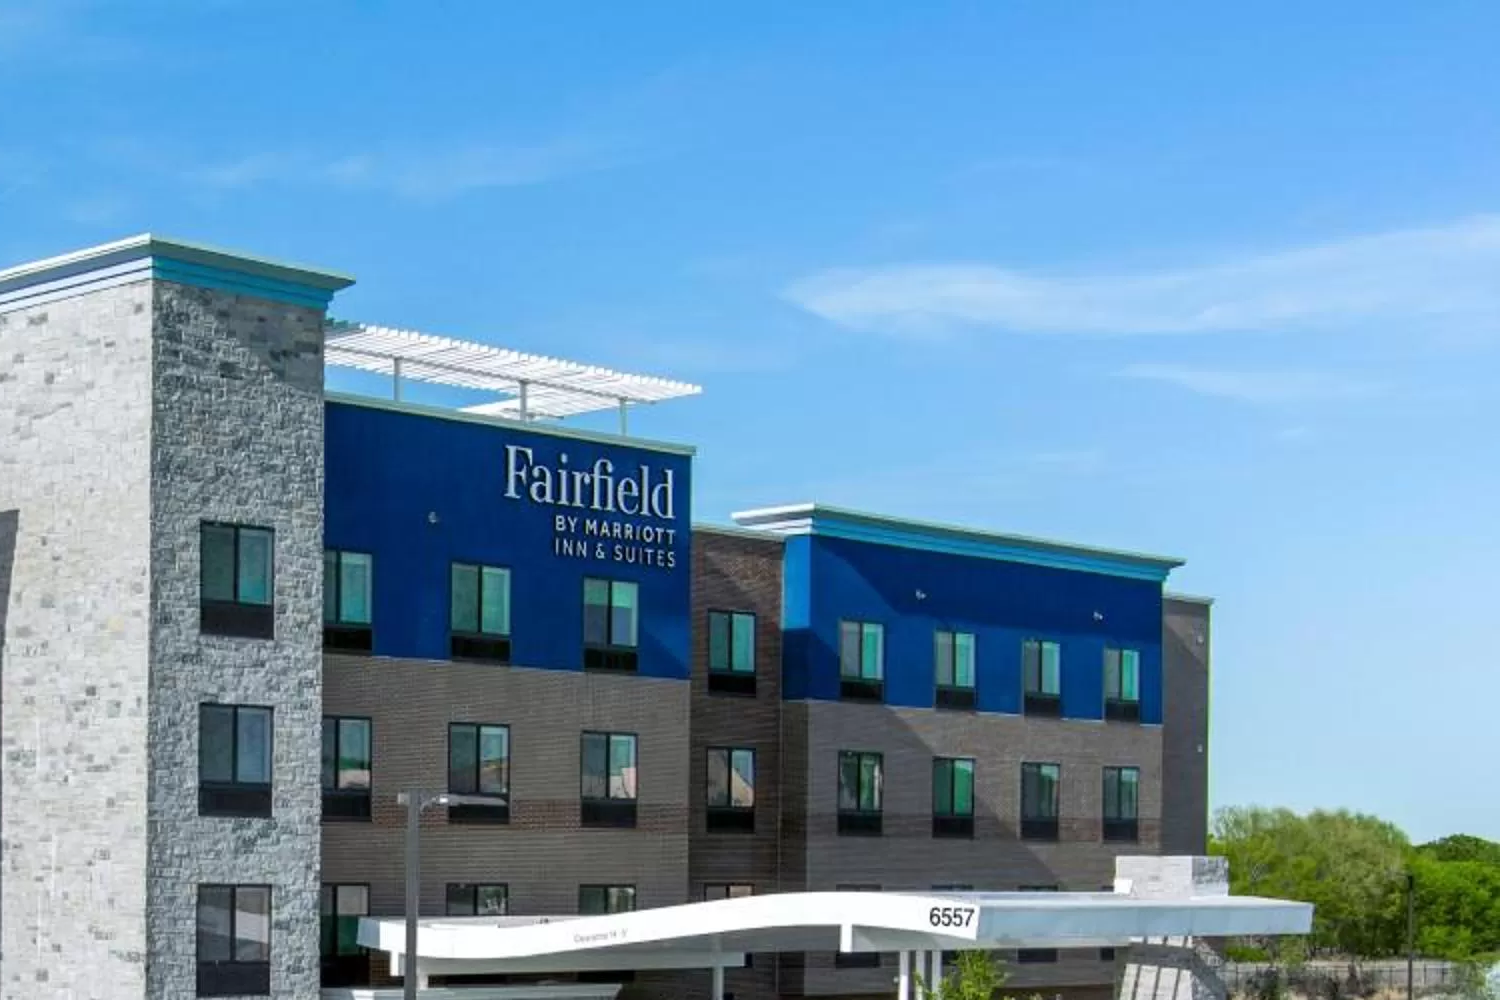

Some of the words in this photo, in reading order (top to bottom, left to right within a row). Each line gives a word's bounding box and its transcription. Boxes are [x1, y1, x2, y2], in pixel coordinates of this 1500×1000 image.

[503, 444, 676, 519] Fairfield
[555, 514, 579, 533] BY
[585, 518, 676, 545] MARRIOTT
[555, 537, 588, 558] INN
[595, 543, 605, 559] &
[613, 543, 676, 568] SUITES
[929, 906, 975, 927] 6557
